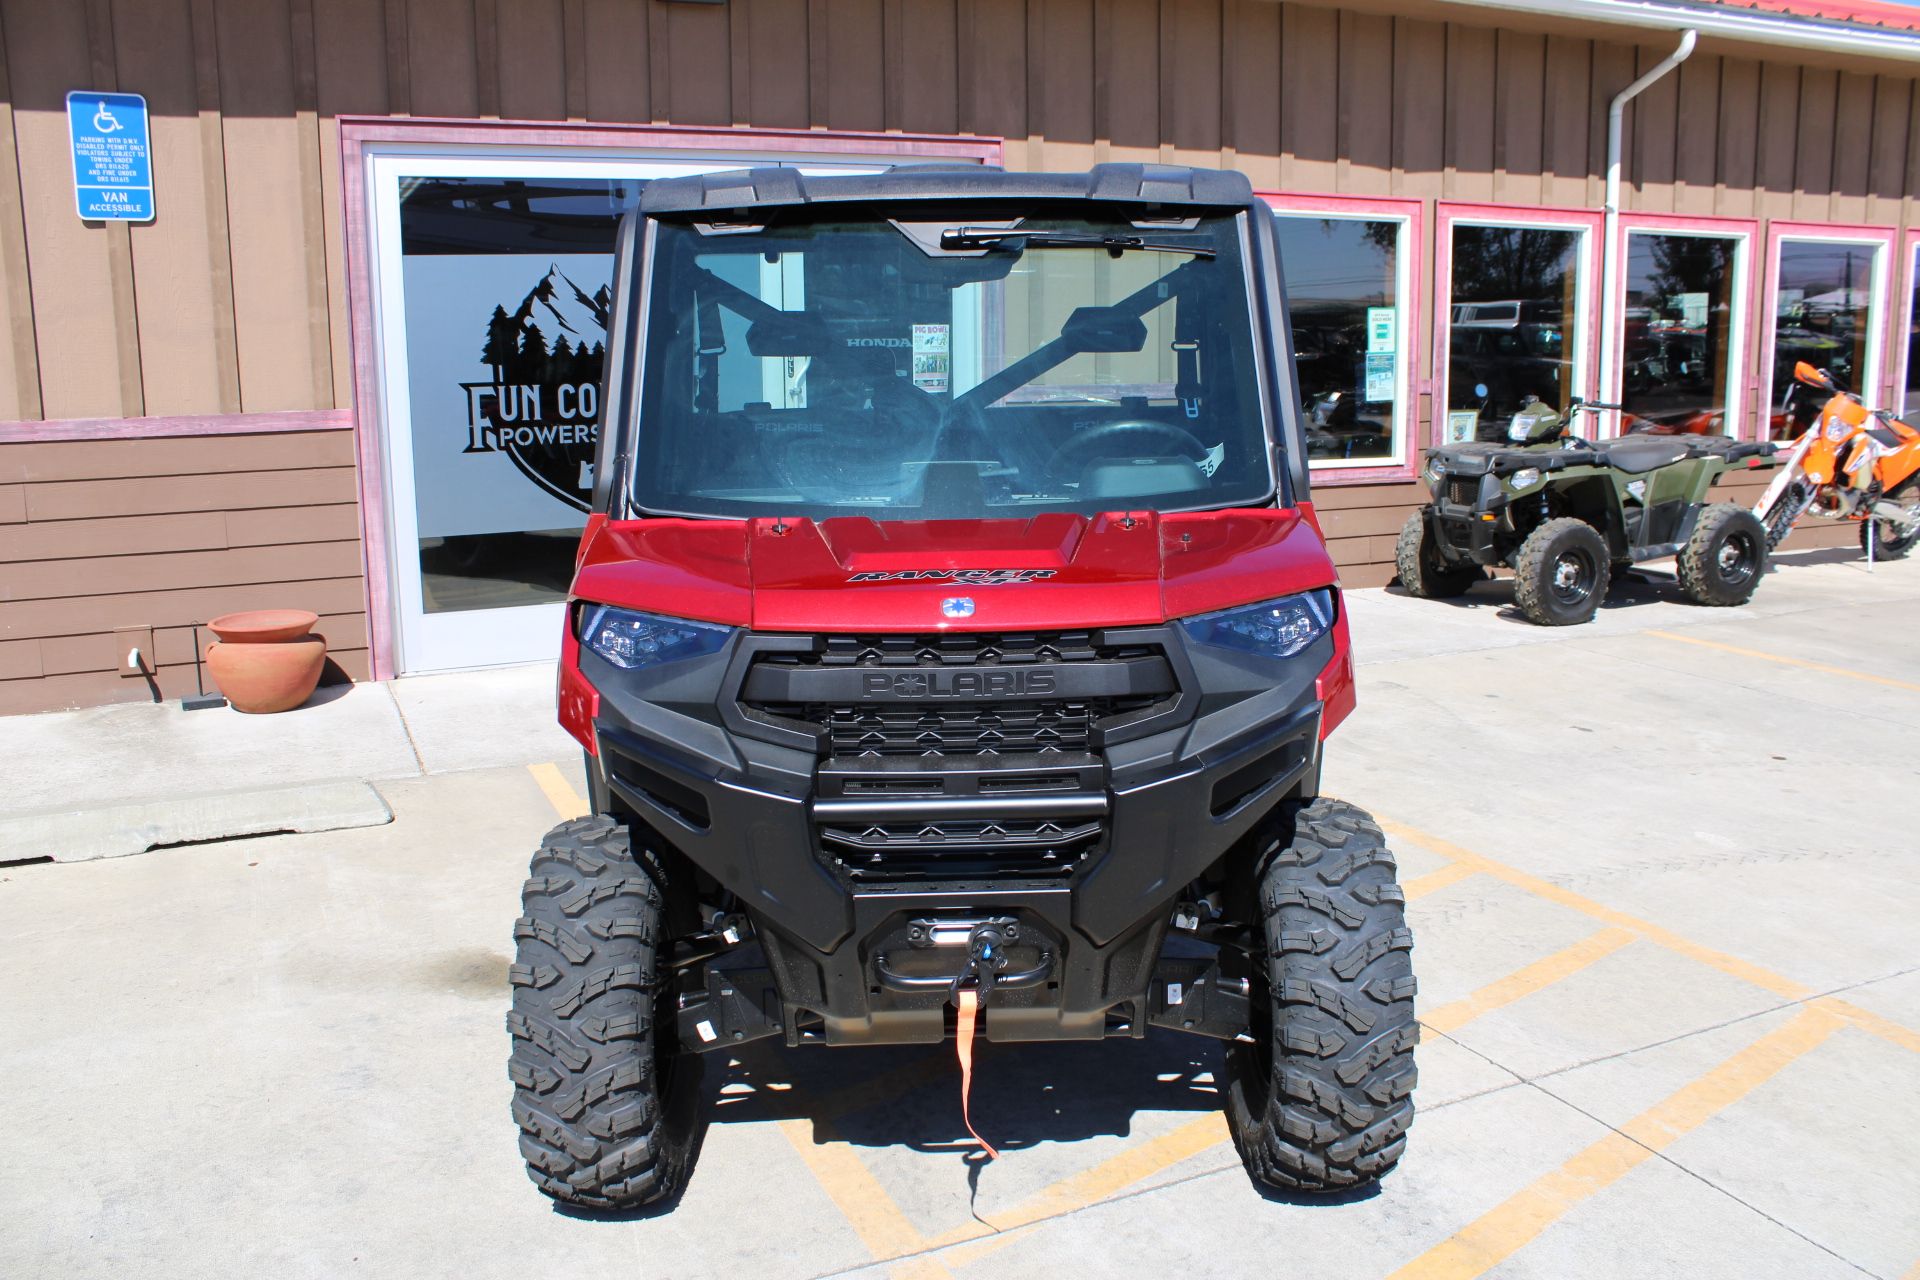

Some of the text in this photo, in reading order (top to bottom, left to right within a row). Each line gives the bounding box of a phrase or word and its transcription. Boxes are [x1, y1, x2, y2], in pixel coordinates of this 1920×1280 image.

[102, 192, 128, 202] VAN
[89, 204, 142, 212] ACCESSIBLE
[846, 338, 913, 348] HONDA
[461, 383, 597, 452] FUN CO
[754, 422, 824, 433] POLARIS
[499, 425, 598, 447] POWERS
[847, 569, 1057, 582] RANGER
[938, 577, 1033, 586] XP
[863, 670, 1057, 698] POLARIS
